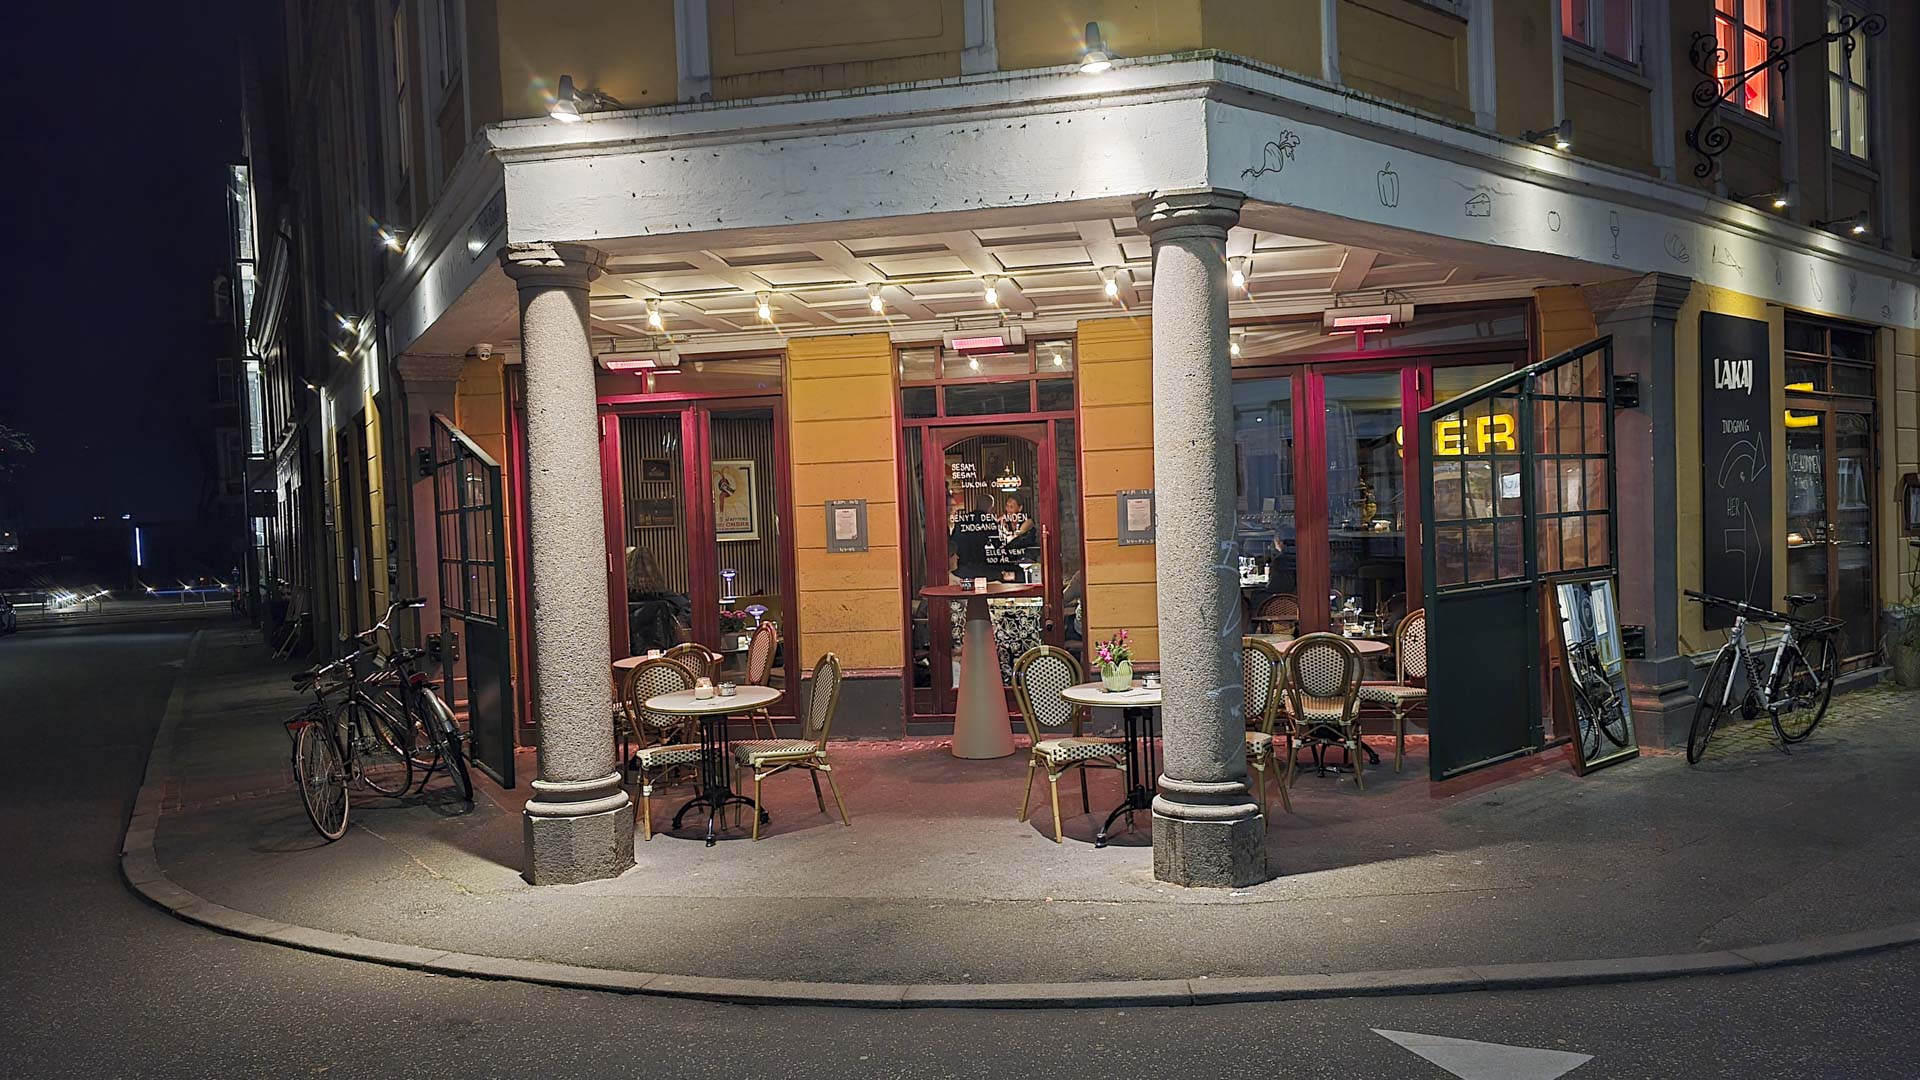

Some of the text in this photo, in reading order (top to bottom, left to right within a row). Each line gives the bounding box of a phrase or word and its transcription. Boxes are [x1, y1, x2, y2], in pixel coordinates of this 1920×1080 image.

[1713, 358, 1753, 395] LAKAJ
[1721, 419, 1750, 434] INDGANG
[1396, 413, 1515, 458] ER
[951, 472, 977, 480] SESAM
[1727, 497, 1741, 518] HER
[980, 513, 997, 522] DEN
[1002, 513, 1028, 522] ANDEN
[960, 522, 997, 532] INDGANG
[1008, 548, 1026, 556] VENT
